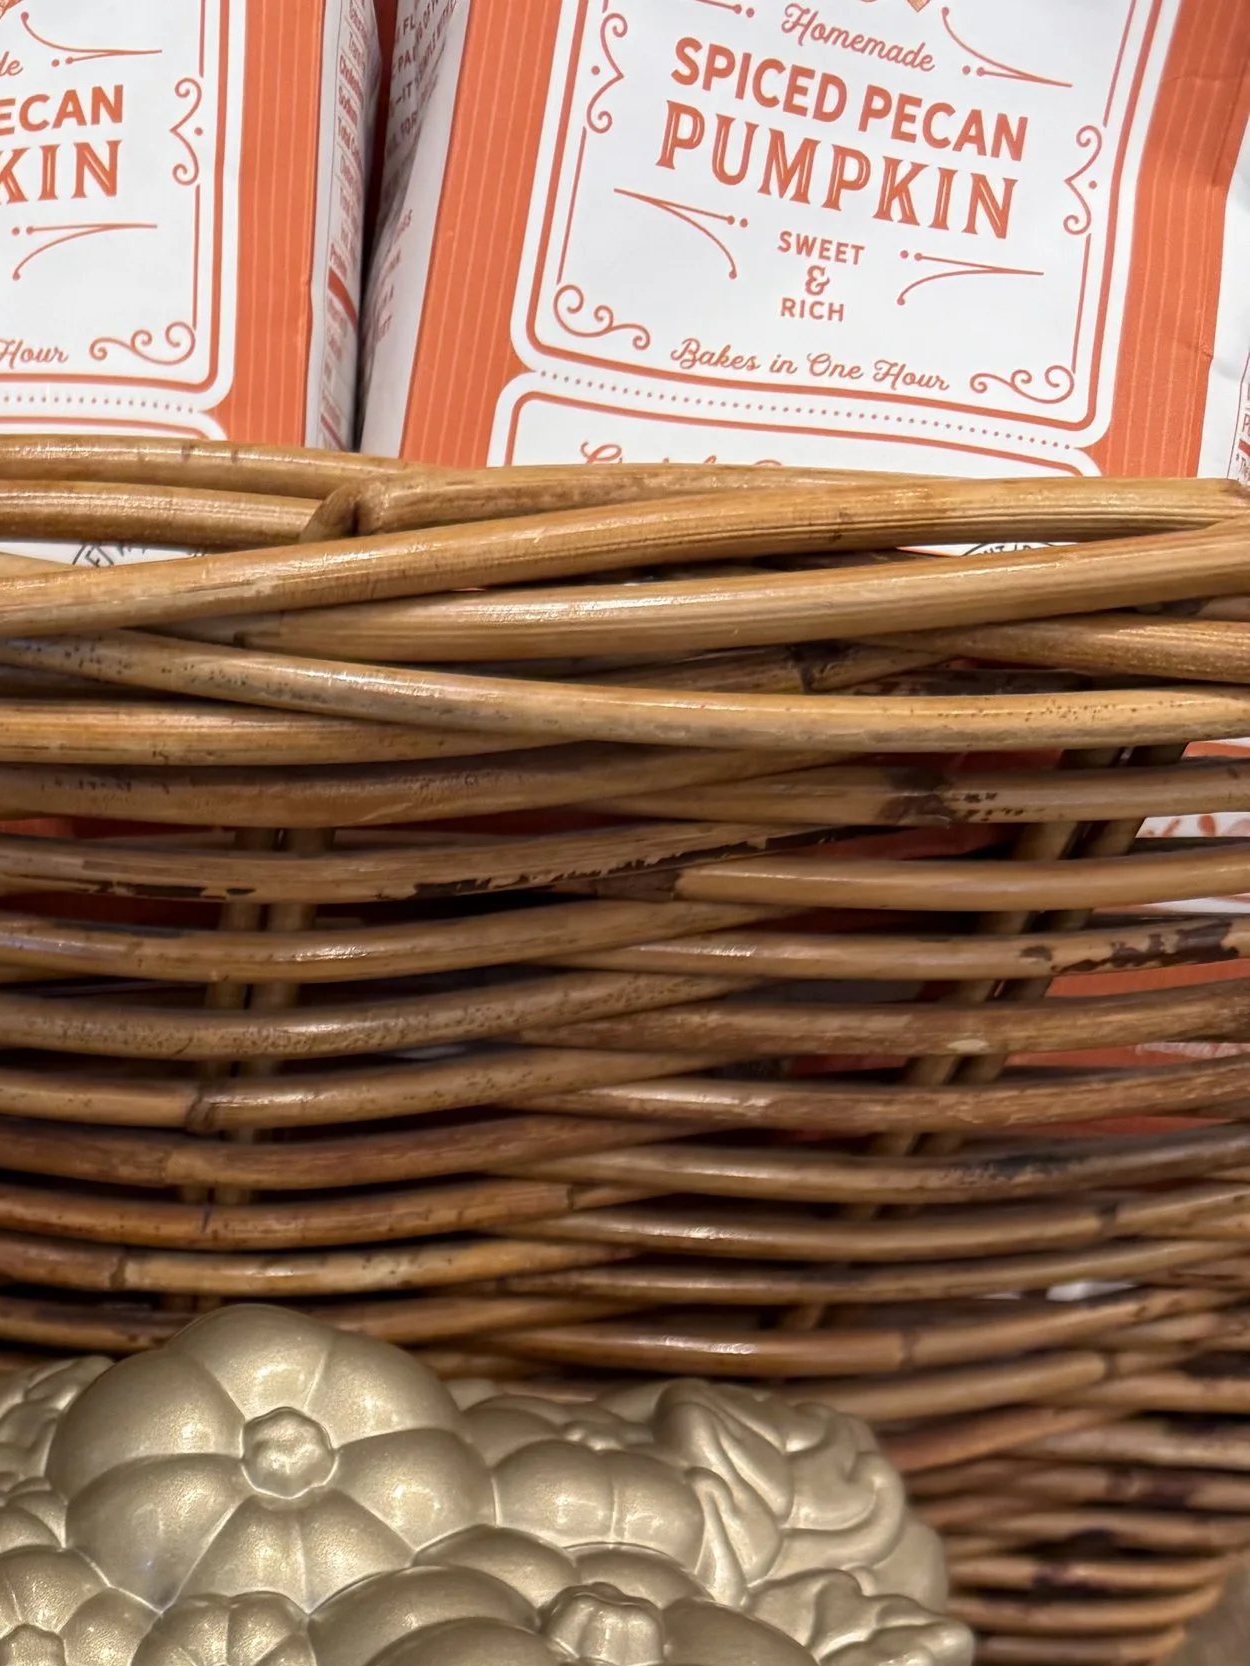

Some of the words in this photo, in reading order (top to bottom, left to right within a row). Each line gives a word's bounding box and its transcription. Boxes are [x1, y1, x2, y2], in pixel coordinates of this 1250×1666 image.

[781, 3, 936, 72] Homemade
[671, 36, 848, 123] SPICED
[858, 84, 1028, 161] PECAN
[656, 100, 1018, 239] PUMPKIN
[777, 231, 865, 264] SWEET
[805, 265, 831, 296] &
[781, 297, 844, 322] RICH
[670, 339, 760, 370] Bakes
[770, 353, 798, 374] in
[807, 353, 864, 379] One
[872, 360, 950, 391] Hour
